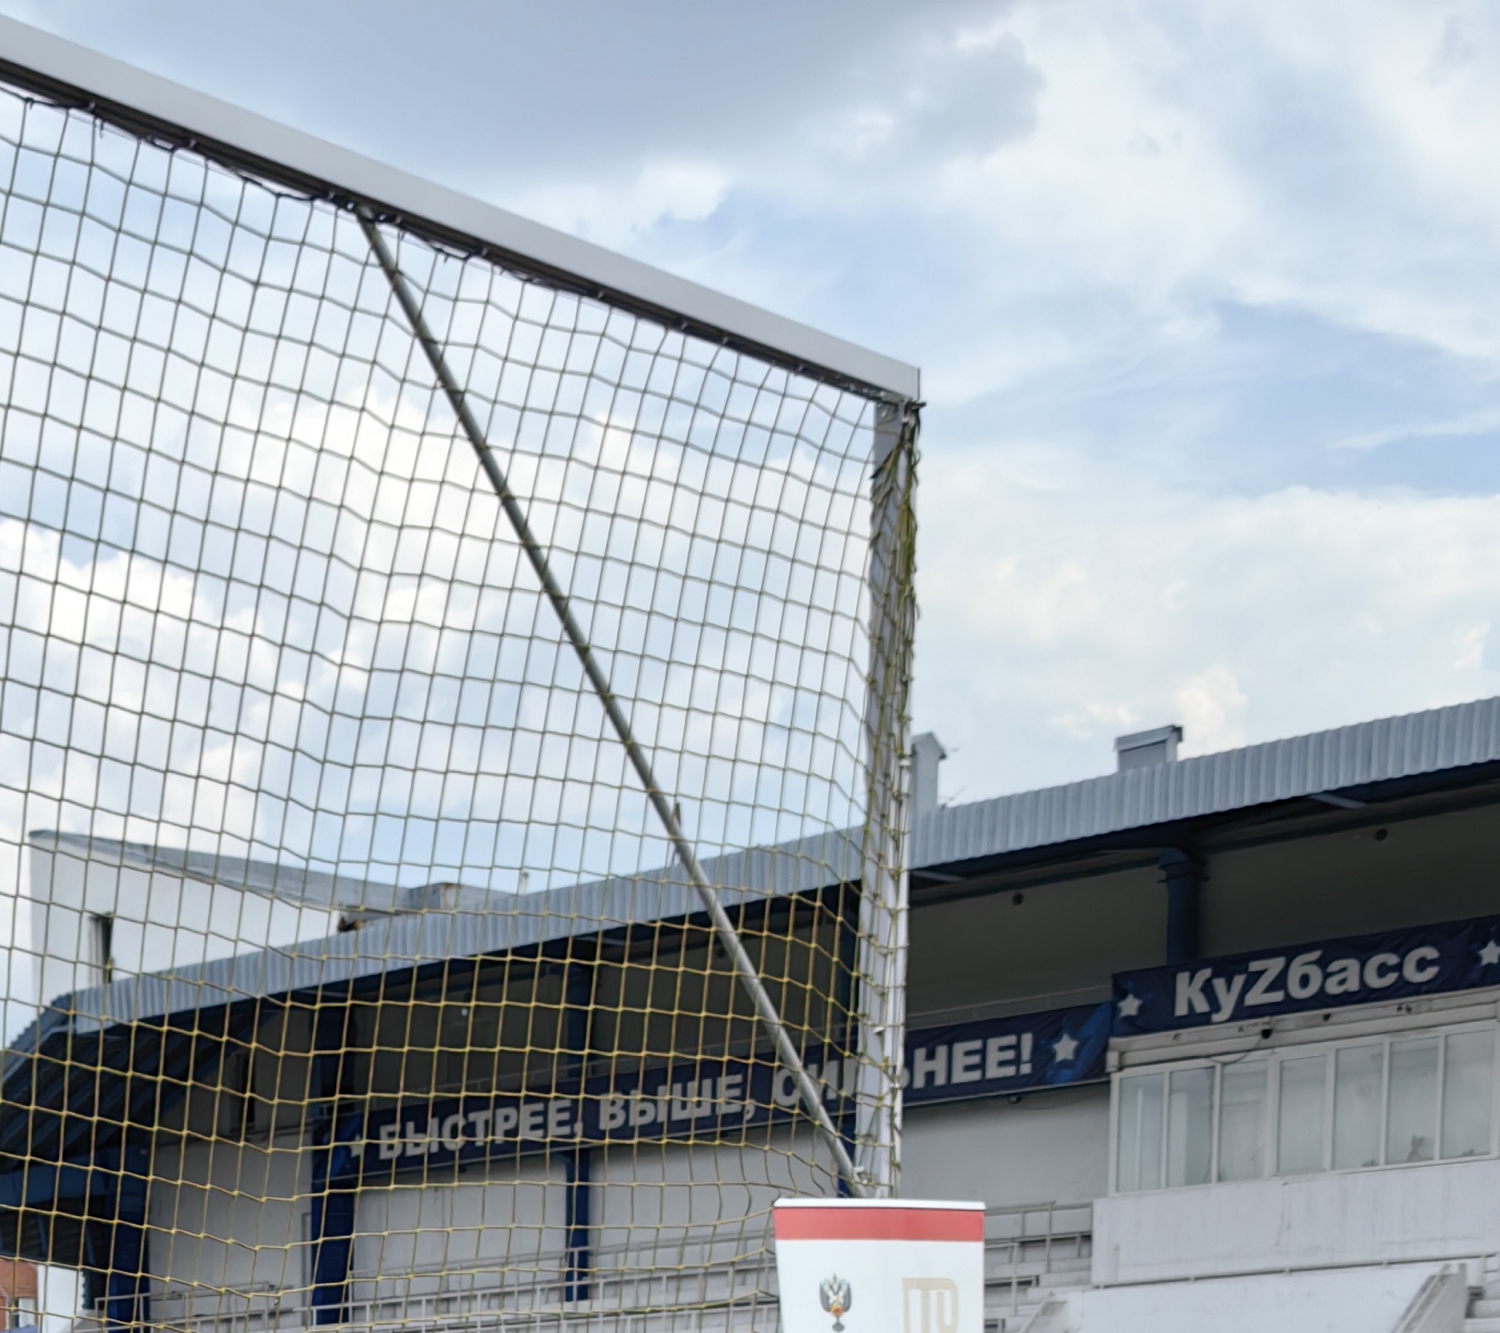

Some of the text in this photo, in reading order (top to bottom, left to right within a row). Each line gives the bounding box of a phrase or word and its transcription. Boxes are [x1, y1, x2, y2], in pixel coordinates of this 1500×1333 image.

[1173, 944, 1441, 1022] КуZбасс
[377, 1033, 1033, 1161] БЫСТРЕЕ, ВЫШЕ, СИНЕЕ!
